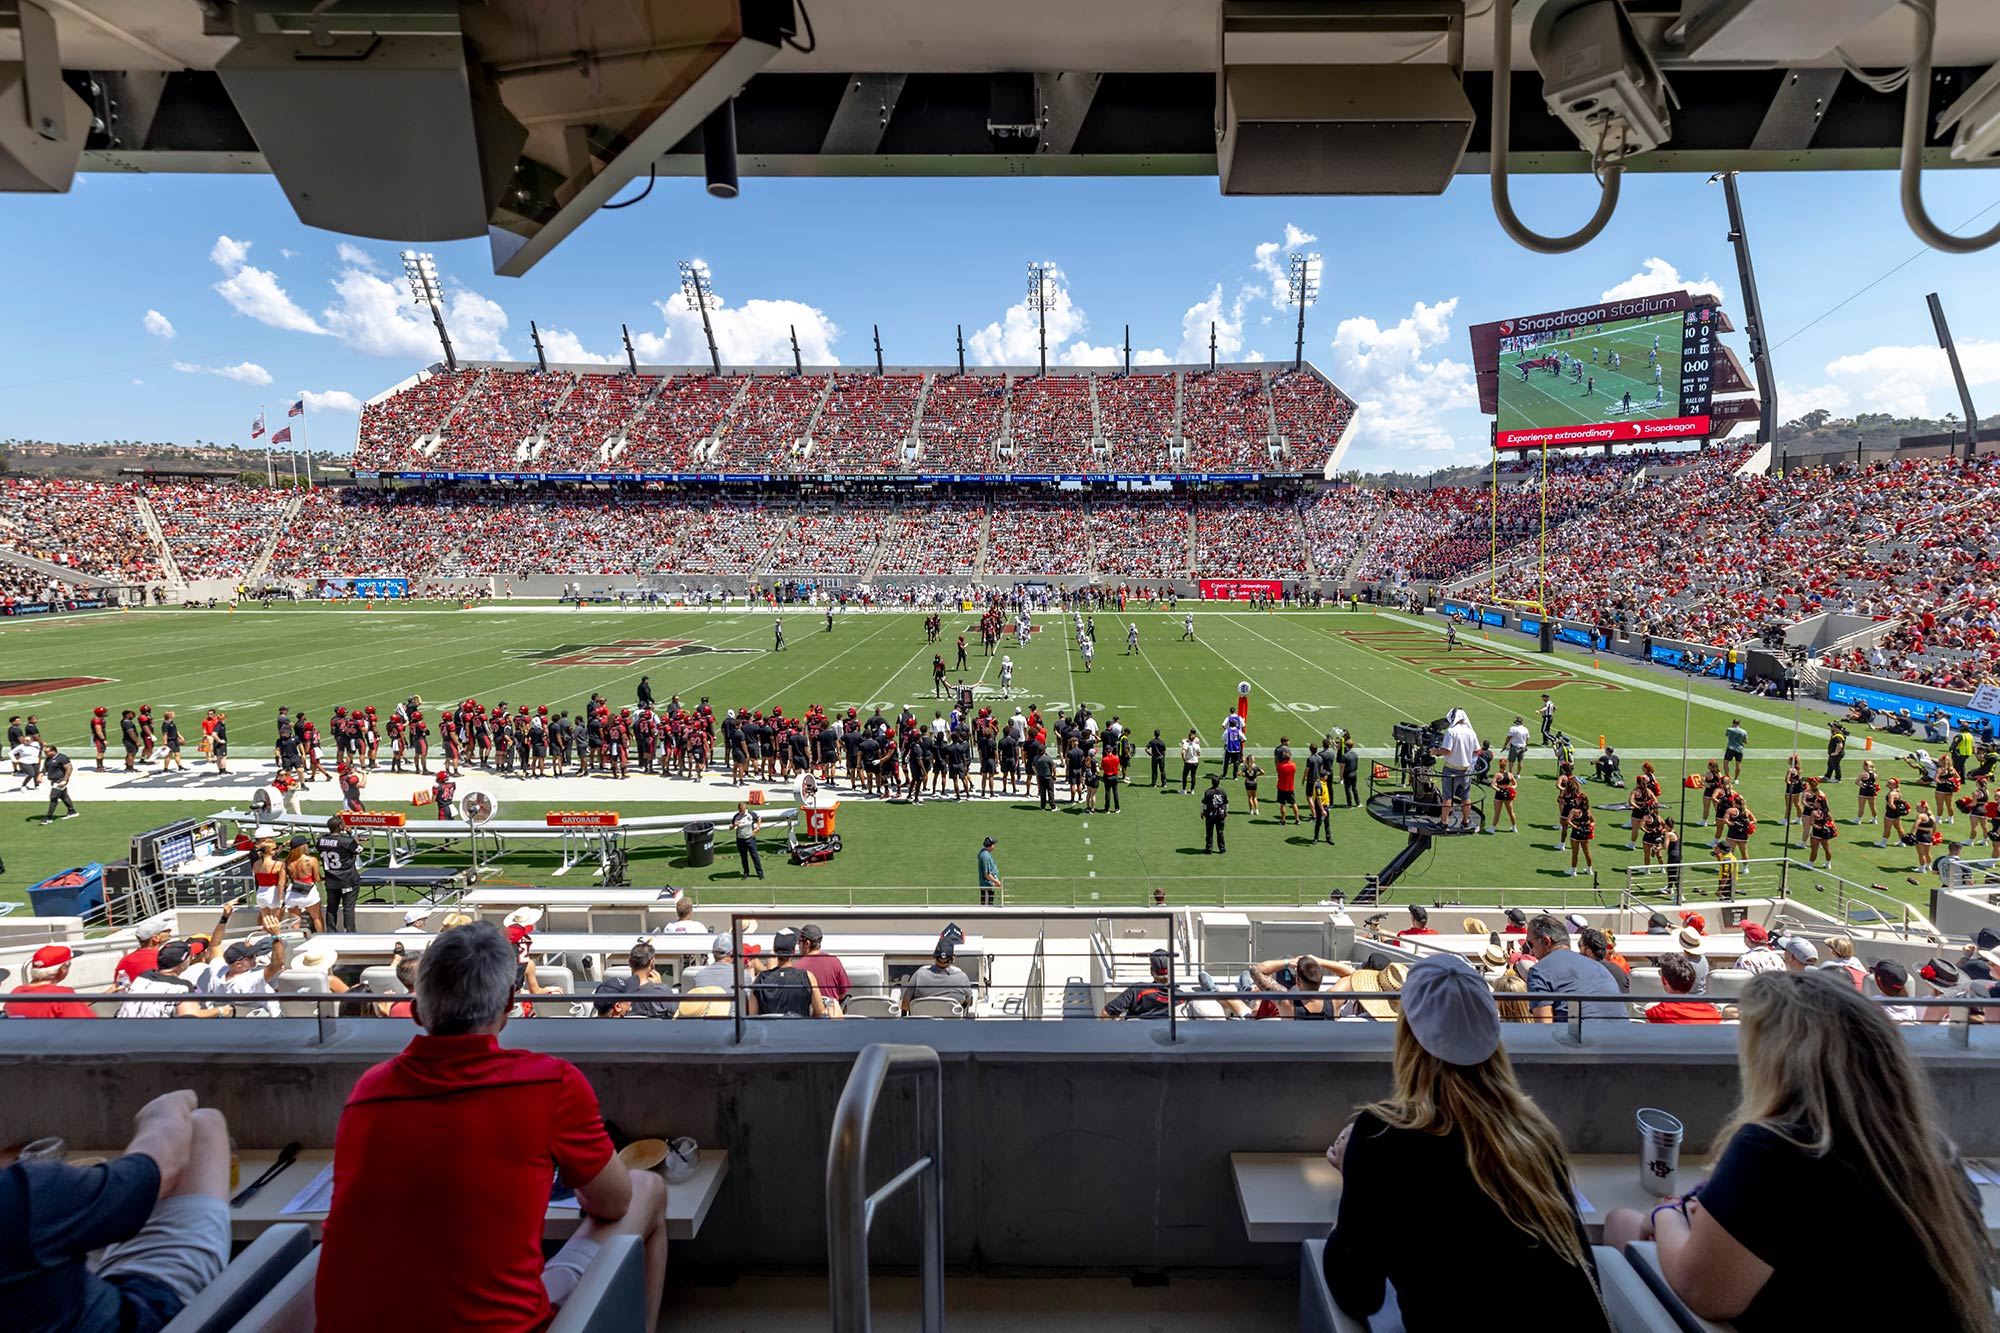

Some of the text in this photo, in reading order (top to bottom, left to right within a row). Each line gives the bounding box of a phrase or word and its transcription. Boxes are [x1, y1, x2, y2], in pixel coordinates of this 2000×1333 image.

[1518, 297, 1676, 332] Snapdragon stadium
[1685, 325, 1709, 339] 10 0
[1684, 360, 1709, 373] 0:00
[1699, 383, 1707, 391] 10
[1690, 405, 1699, 414] 24
[1644, 423, 1695, 433] Snapdragon
[1507, 428, 1614, 444] Experience extraordinary
[817, 578, 842, 588] FIELD
[827, 702, 895, 711] 30
[1044, 702, 1105, 711] 20
[1265, 702, 1319, 712] 10
[350, 816, 386, 824] GATORADE
[811, 814, 825, 829] G
[320, 851, 342, 870] 13
